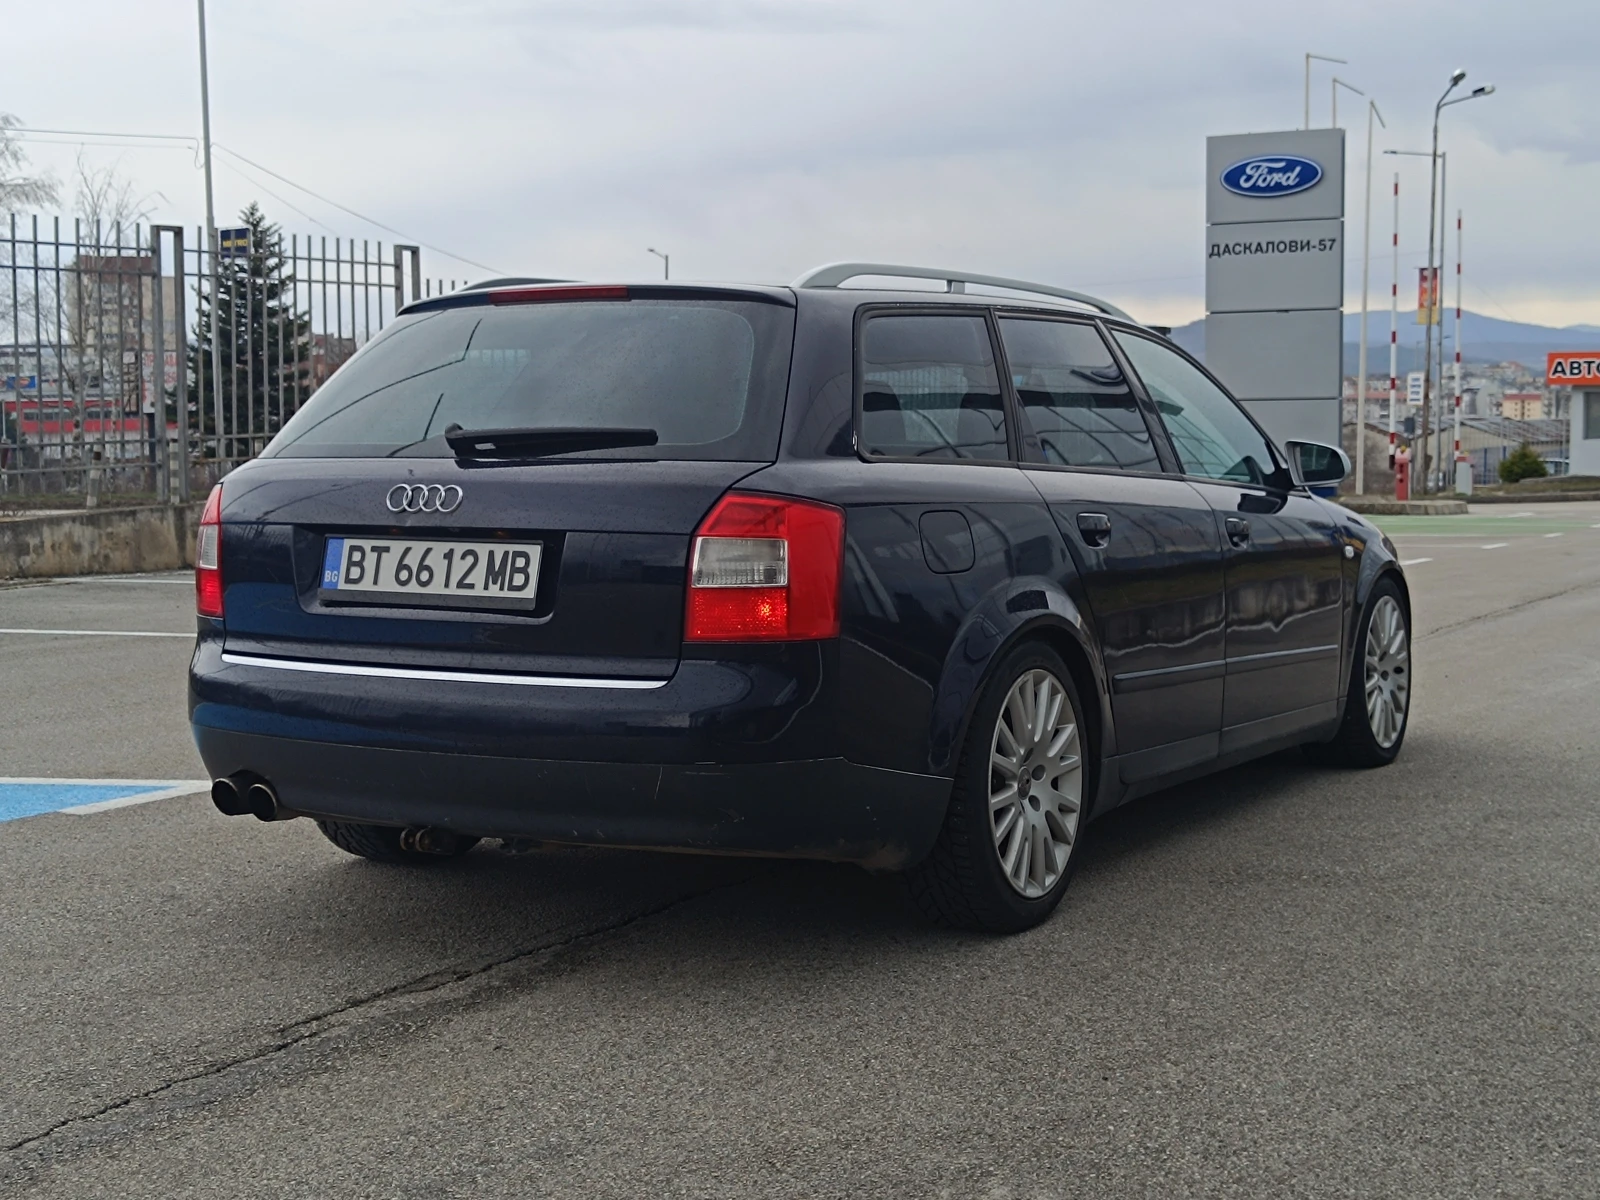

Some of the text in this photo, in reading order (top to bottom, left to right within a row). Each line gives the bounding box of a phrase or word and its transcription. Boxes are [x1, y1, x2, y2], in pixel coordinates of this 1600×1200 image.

[1239, 161, 1302, 188] Ford
[1209, 238, 1337, 259] ДАСКАЛОВИ-57
[1550, 359, 1600, 377] АВТ
[324, 570, 338, 583] BG
